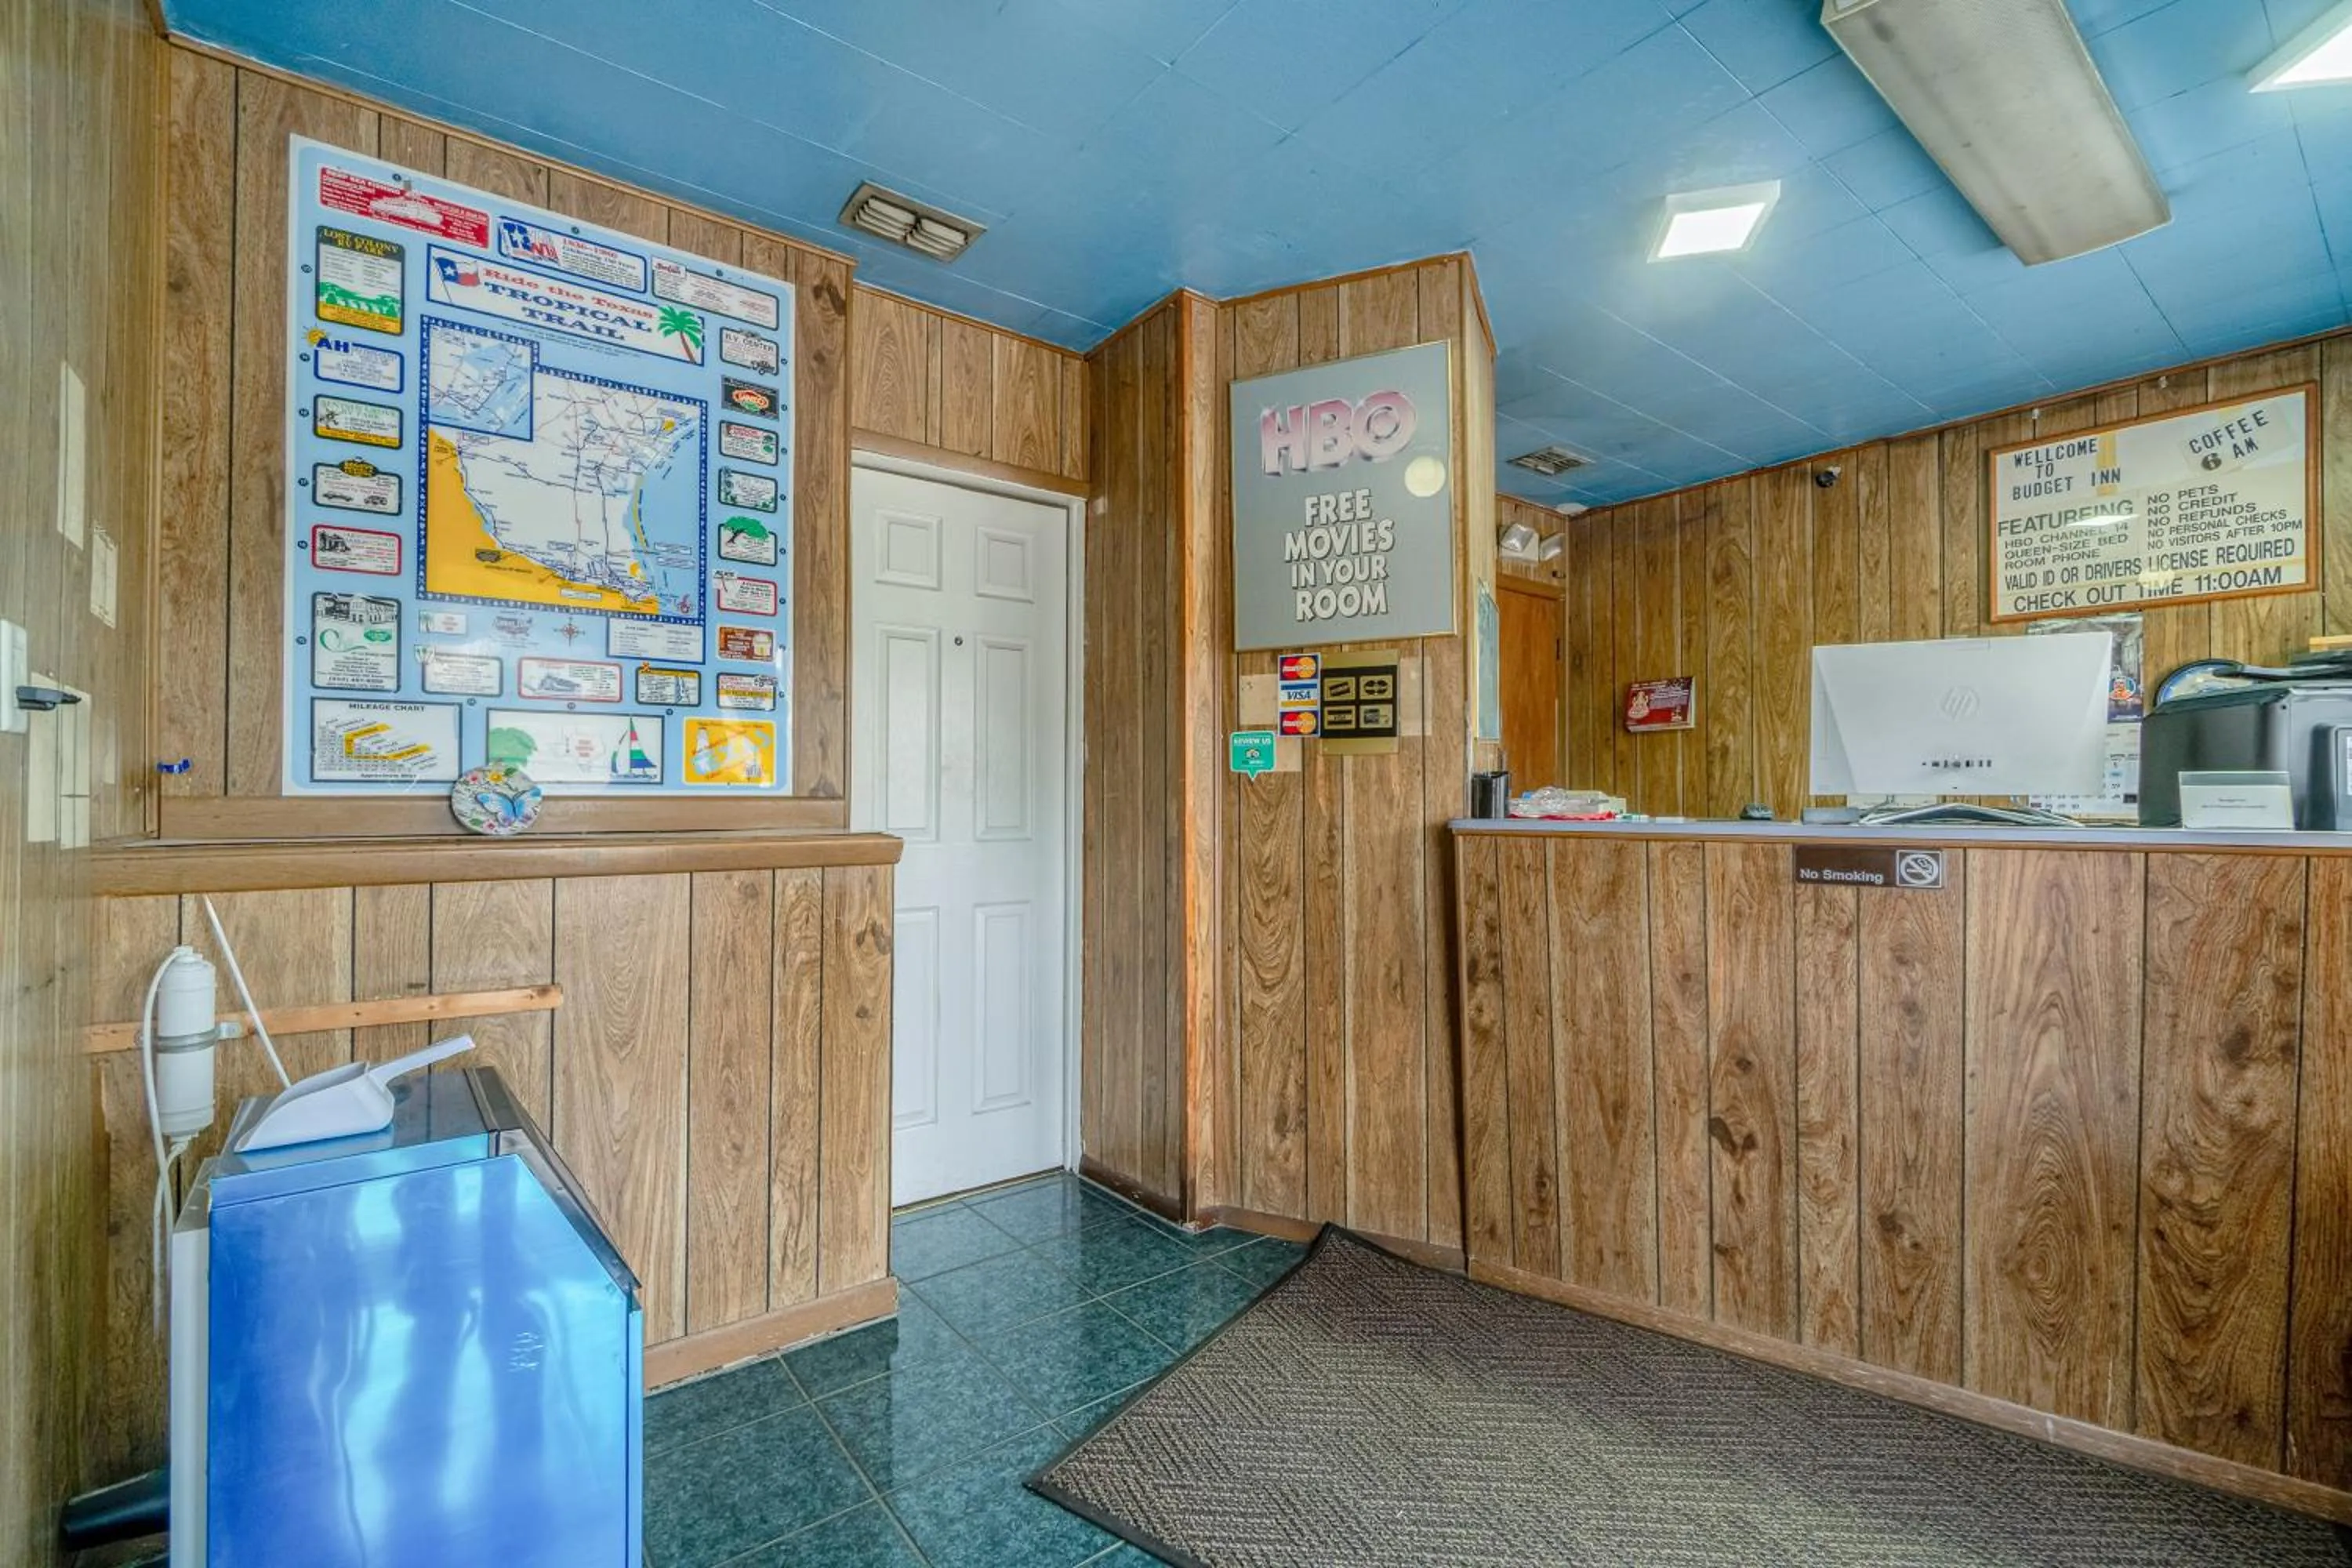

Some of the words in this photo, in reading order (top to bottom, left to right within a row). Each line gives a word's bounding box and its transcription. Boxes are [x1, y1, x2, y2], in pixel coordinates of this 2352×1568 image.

[482, 267, 539, 290] Ride
[547, 281, 586, 300] the
[591, 296, 653, 319] Texas
[484, 281, 653, 332] TROPICAL
[521, 306, 626, 341] TRAIL
[317, 338, 350, 354] AH
[1260, 390, 1418, 477] HBO
[2189, 409, 2269, 454] COFFEE
[2014, 437, 2098, 468] WELLCOME
[2233, 437, 2259, 459] AM
[2013, 476, 2074, 501] BUDGET
[2091, 467, 2121, 487] INN
[2035, 463, 2054, 479] TO
[1305, 488, 1372, 527] FREE
[2147, 492, 2170, 506] NO
[2178, 484, 2219, 501] PETS
[2147, 504, 2170, 517] NO
[2178, 492, 2238, 512] CREDIT
[2147, 516, 2170, 528] NO
[2179, 503, 2256, 523] REFUNDS
[2148, 528, 2165, 539] NO
[2169, 518, 2230, 535] PERSONAL
[2235, 509, 2287, 526] CHECKS
[1284, 518, 1395, 563] MOVIES
[2005, 537, 2033, 549] HBO
[2040, 526, 2107, 543] CHANNEL
[2114, 522, 2128, 532] 14
[2005, 539, 2091, 560] QUEEN-SIZE
[2098, 534, 2129, 546] BED
[2148, 539, 2164, 551] NO
[2169, 531, 2220, 546] VISITORS
[2226, 524, 2265, 539] AFTER
[2270, 518, 2302, 533] 10PM
[1292, 561, 1316, 590] IN
[1321, 554, 1389, 585] YOUR
[2005, 557, 2045, 571] ROOM
[2053, 549, 2101, 564] PHONE
[2005, 572, 2037, 590] VALID
[2043, 570, 2055, 586] ID
[2060, 567, 2078, 584] OR
[2085, 557, 2142, 581] DRIVERS
[2149, 549, 2208, 572] LICENSE
[2216, 537, 2295, 565] REQUIRED
[1295, 583, 1388, 622] ROOM
[2014, 590, 2077, 612] CHECK
[2086, 583, 2127, 604] OUT
[2136, 576, 2183, 598] TIME
[2195, 566, 2281, 593] 11:00AM
[349, 702, 391, 711] MILEAGE
[394, 703, 426, 712] CHART
[1287, 691, 1312, 700] VISA
[1800, 868, 1819, 880] No
[1823, 868, 1884, 885] Smoking
